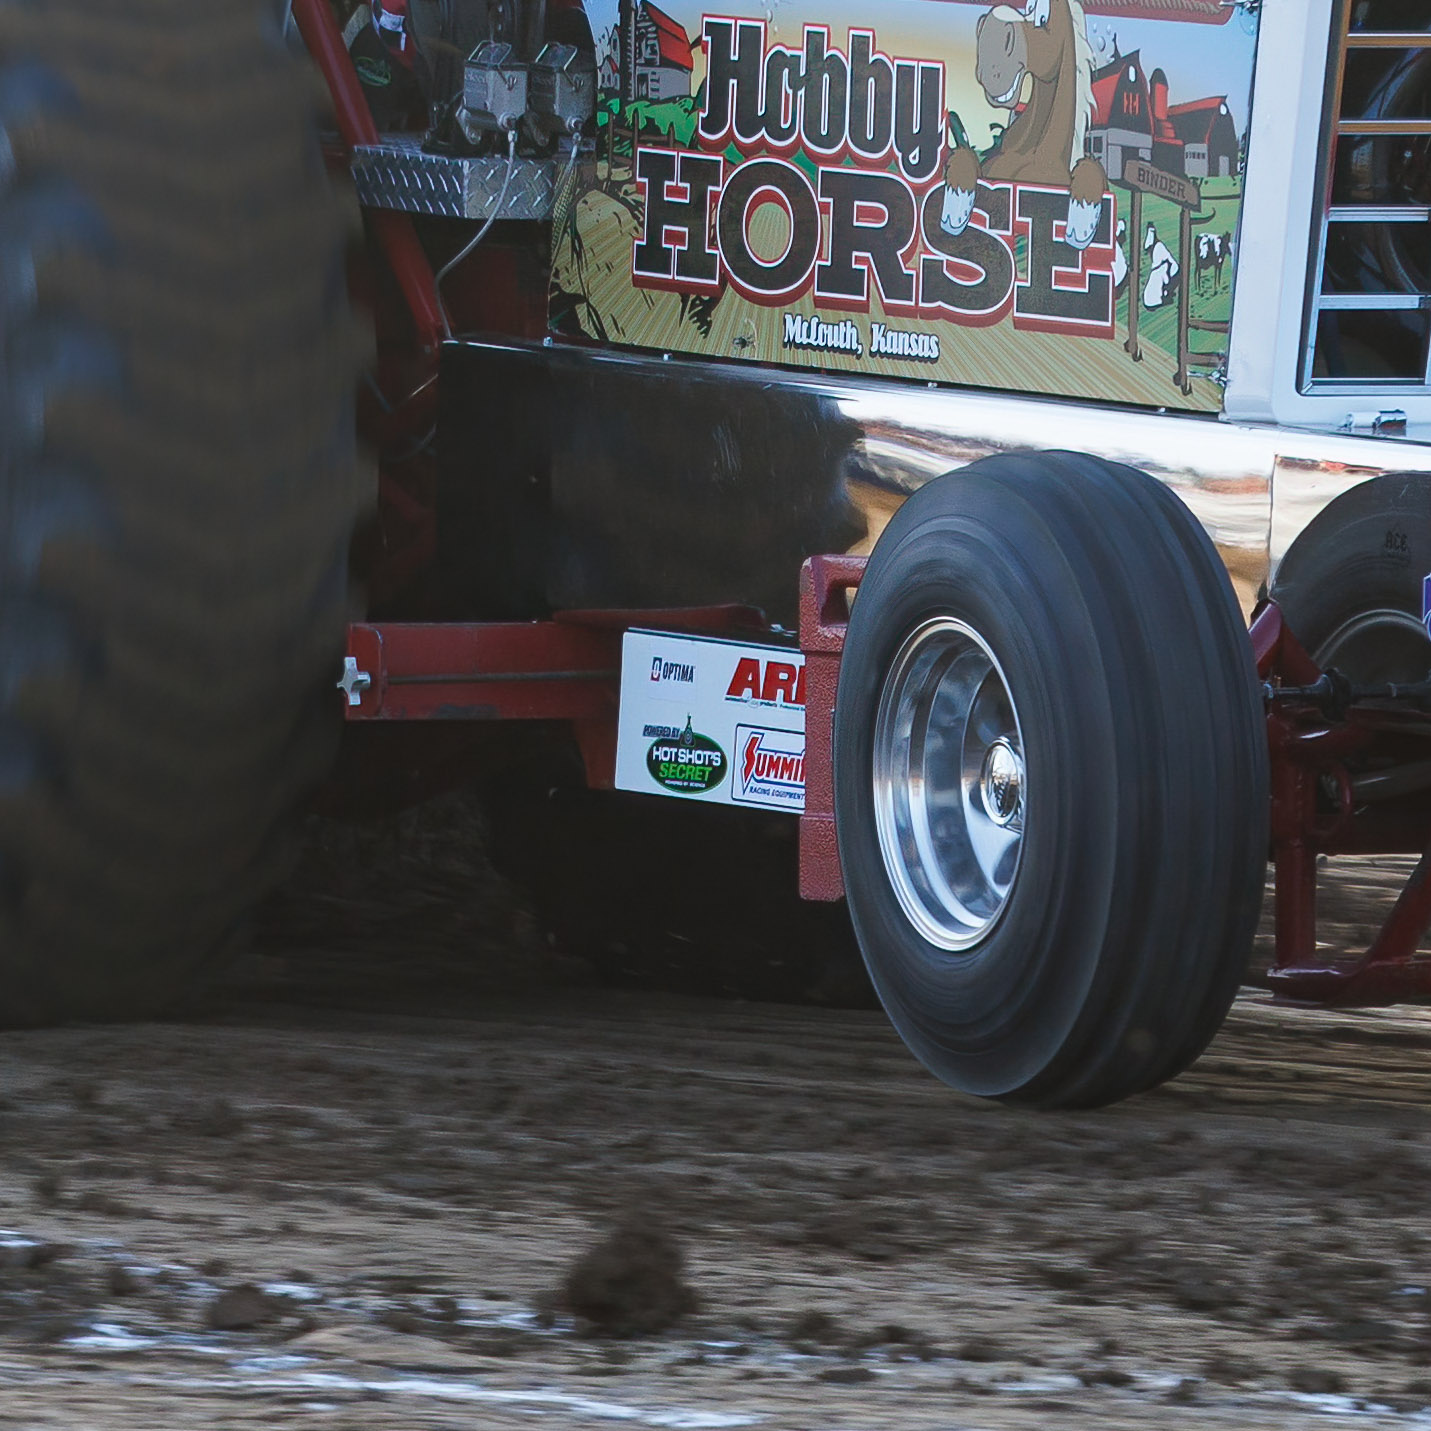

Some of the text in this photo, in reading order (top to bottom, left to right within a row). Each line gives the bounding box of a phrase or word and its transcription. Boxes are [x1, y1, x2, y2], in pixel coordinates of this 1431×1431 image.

[698, 14, 947, 187] Hobby
[1138, 168, 1186, 199] BINDER
[632, 146, 1115, 340] HORSE
[784, 313, 940, 359] McLouth, Kansas
[662, 662, 694, 683] OPTIMA
[653, 746, 676, 761] HOT
[659, 762, 713, 781] SECRET
